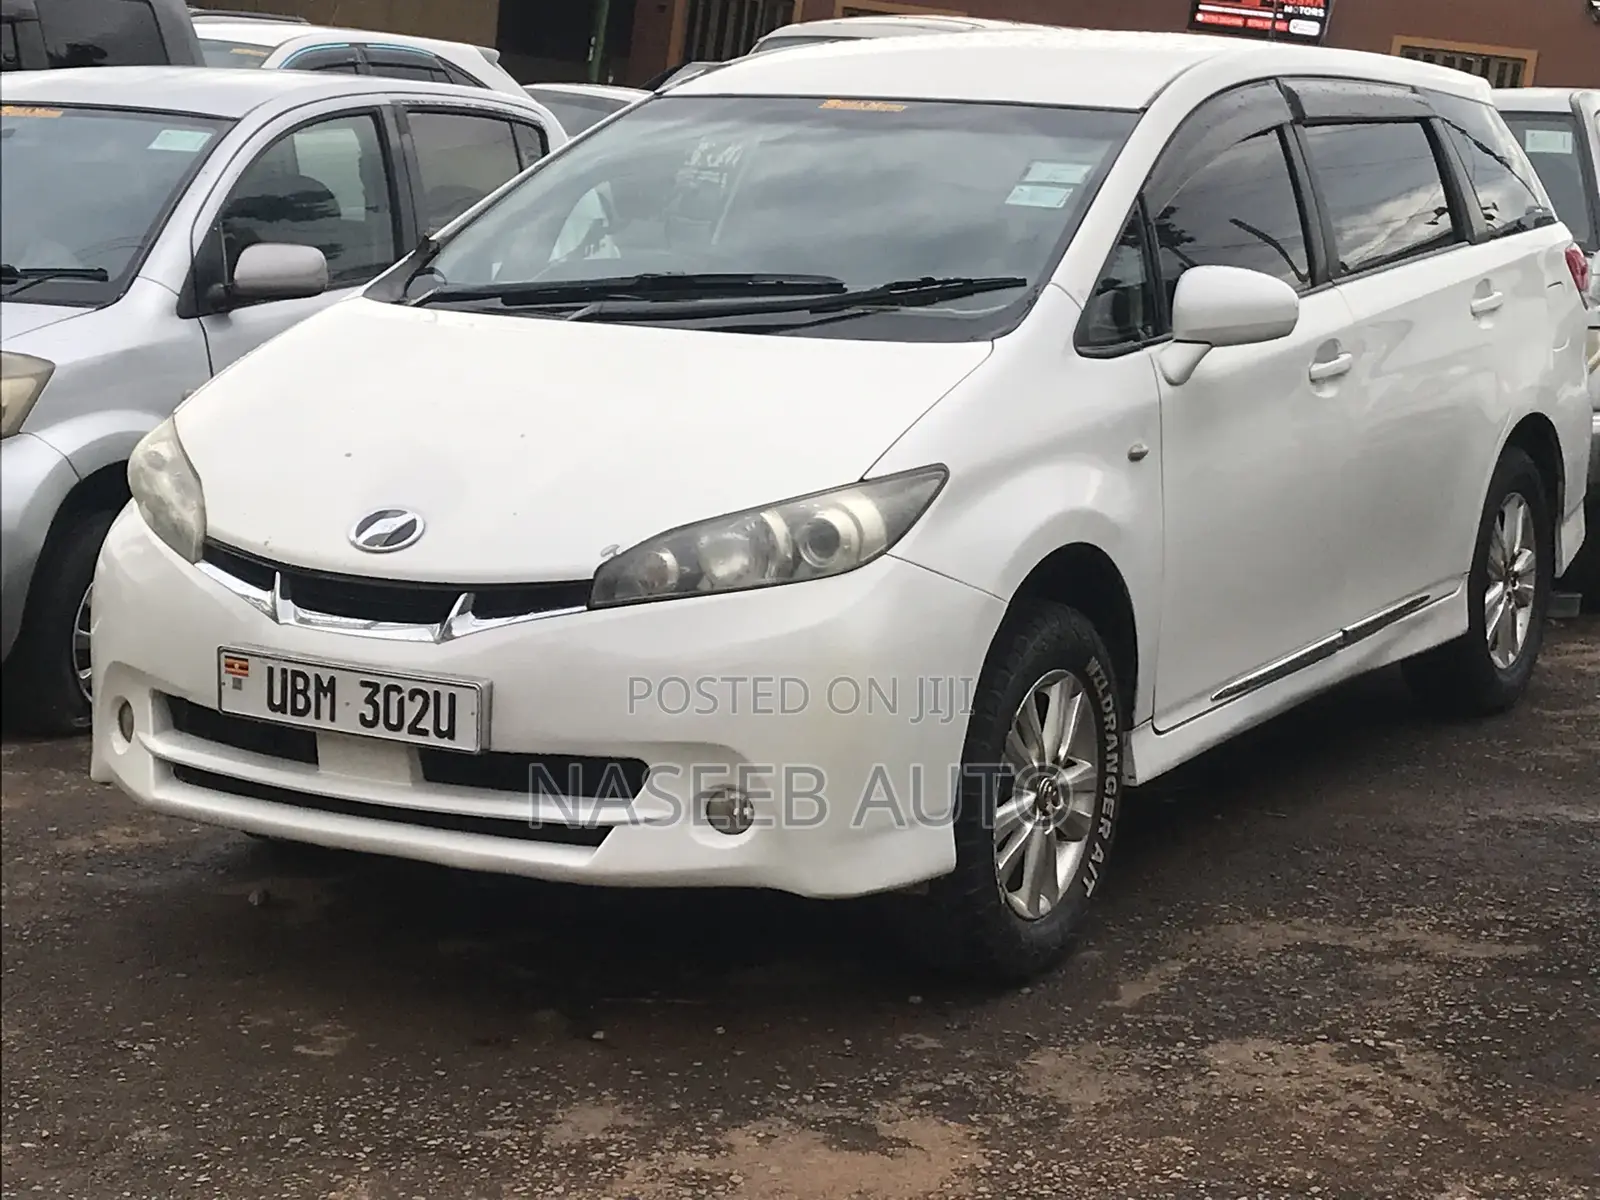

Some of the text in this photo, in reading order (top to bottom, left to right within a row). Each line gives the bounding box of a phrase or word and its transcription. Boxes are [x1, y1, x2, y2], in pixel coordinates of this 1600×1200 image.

[266, 665, 456, 740] UBM 302U
[1082, 656, 1118, 898] WILDRANGER A/T
